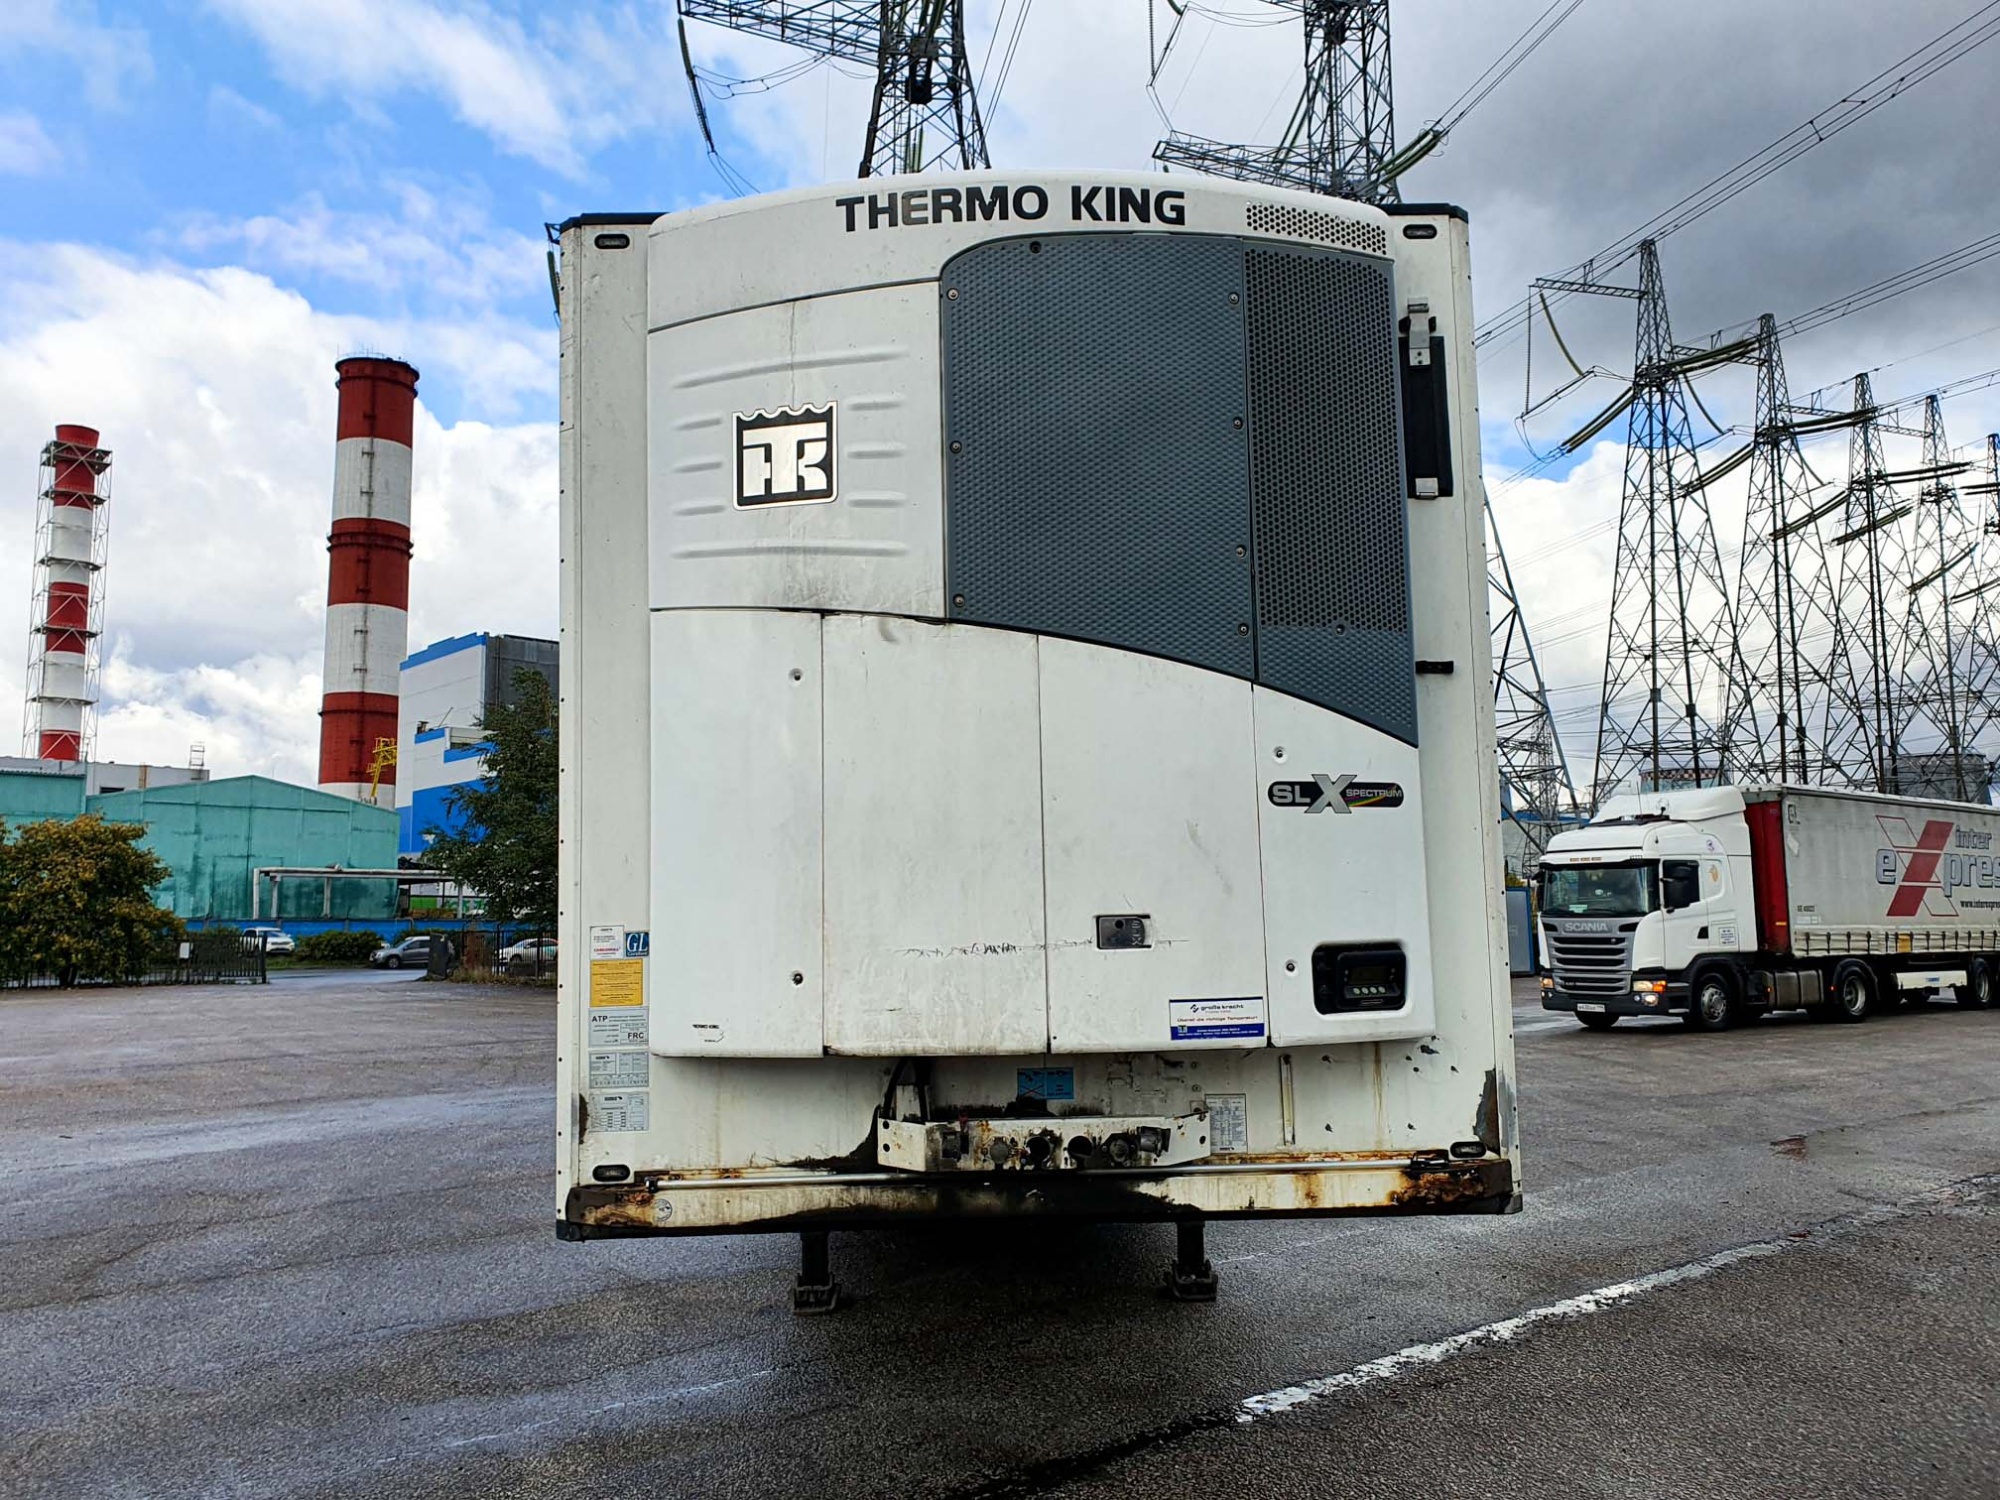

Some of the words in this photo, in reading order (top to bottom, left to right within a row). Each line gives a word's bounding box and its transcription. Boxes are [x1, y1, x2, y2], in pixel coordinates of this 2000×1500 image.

[835, 185, 1049, 232] THERMO
[1070, 185, 1186, 226] KING
[1345, 788, 1403, 798] SPECTRUM
[1955, 825, 1992, 850] inter
[1564, 921, 1608, 932] SCANIA
[627, 933, 649, 952] GL
[591, 1015, 608, 1023] ATP
